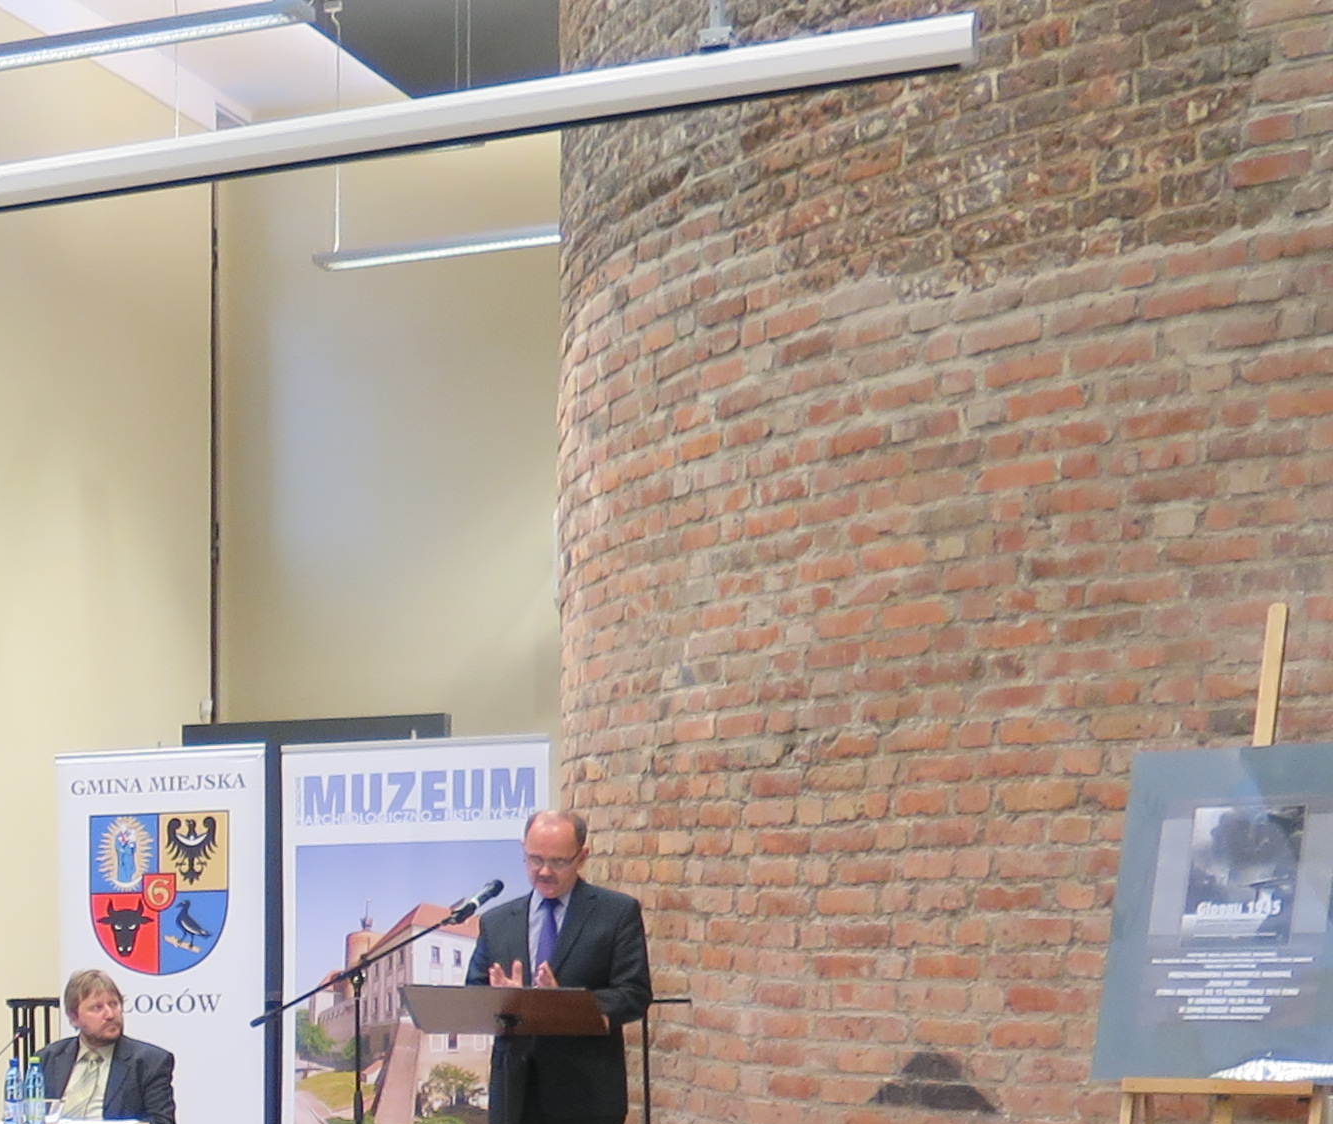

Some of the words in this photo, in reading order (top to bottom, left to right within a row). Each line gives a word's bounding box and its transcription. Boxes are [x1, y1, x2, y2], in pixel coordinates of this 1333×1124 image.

[70, 777, 144, 797] GMINA
[148, 772, 247, 794] MIEJSKA
[303, 766, 536, 825] MUZEUM
[122, 987, 223, 1014] ŁOGÓW
